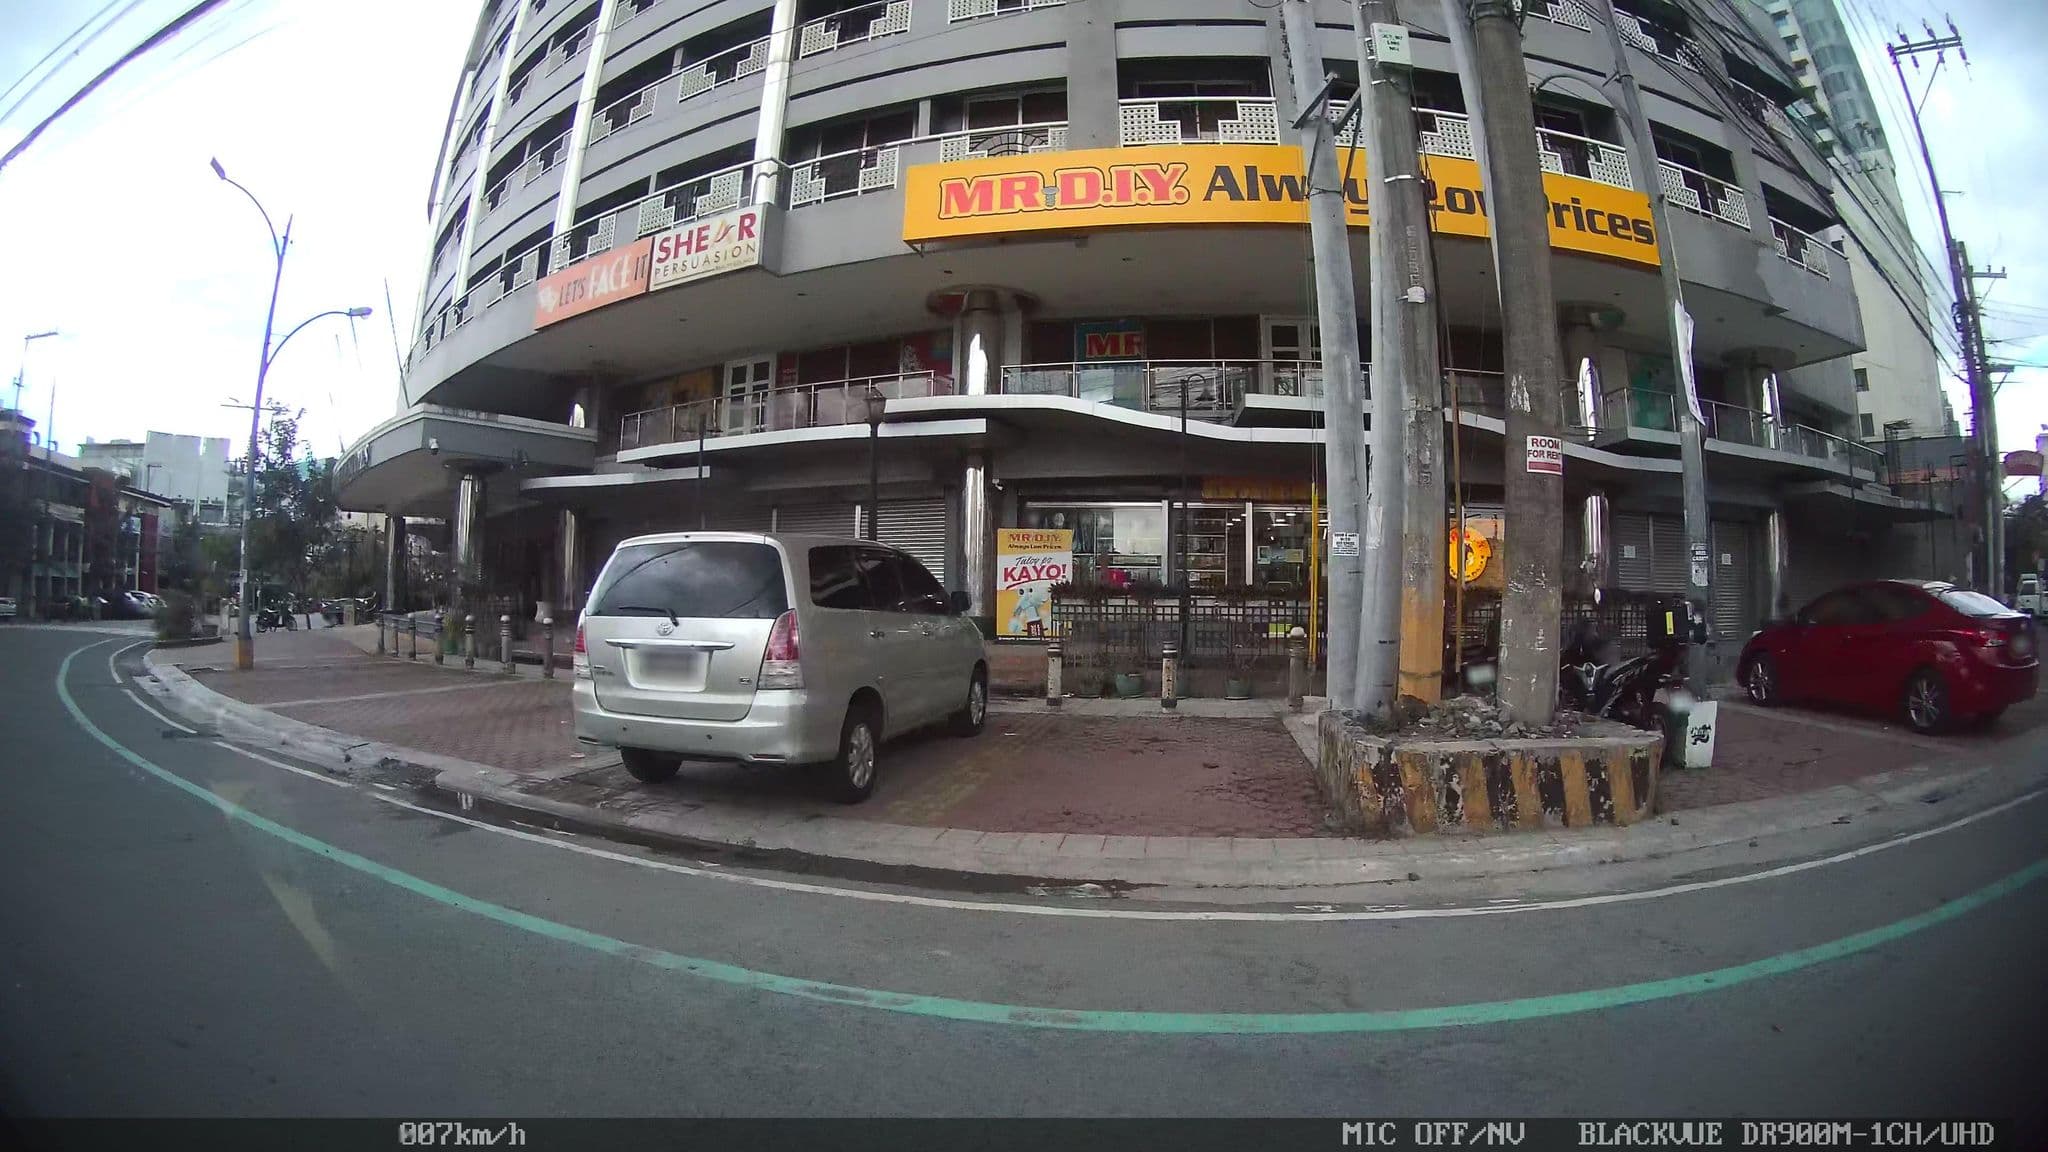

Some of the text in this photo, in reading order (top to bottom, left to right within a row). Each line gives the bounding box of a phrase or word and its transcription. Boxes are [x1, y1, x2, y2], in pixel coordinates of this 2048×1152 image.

[654, 242, 756, 279] PERSUASION
[588, 253, 632, 298] FACE
[634, 253, 649, 281] IT
[1531, 437, 1560, 449] ROOM
[1527, 449, 1545, 459] FOR
[1015, 555, 1053, 567] Tuloy po
[1003, 564, 1067, 582] KAYO!
